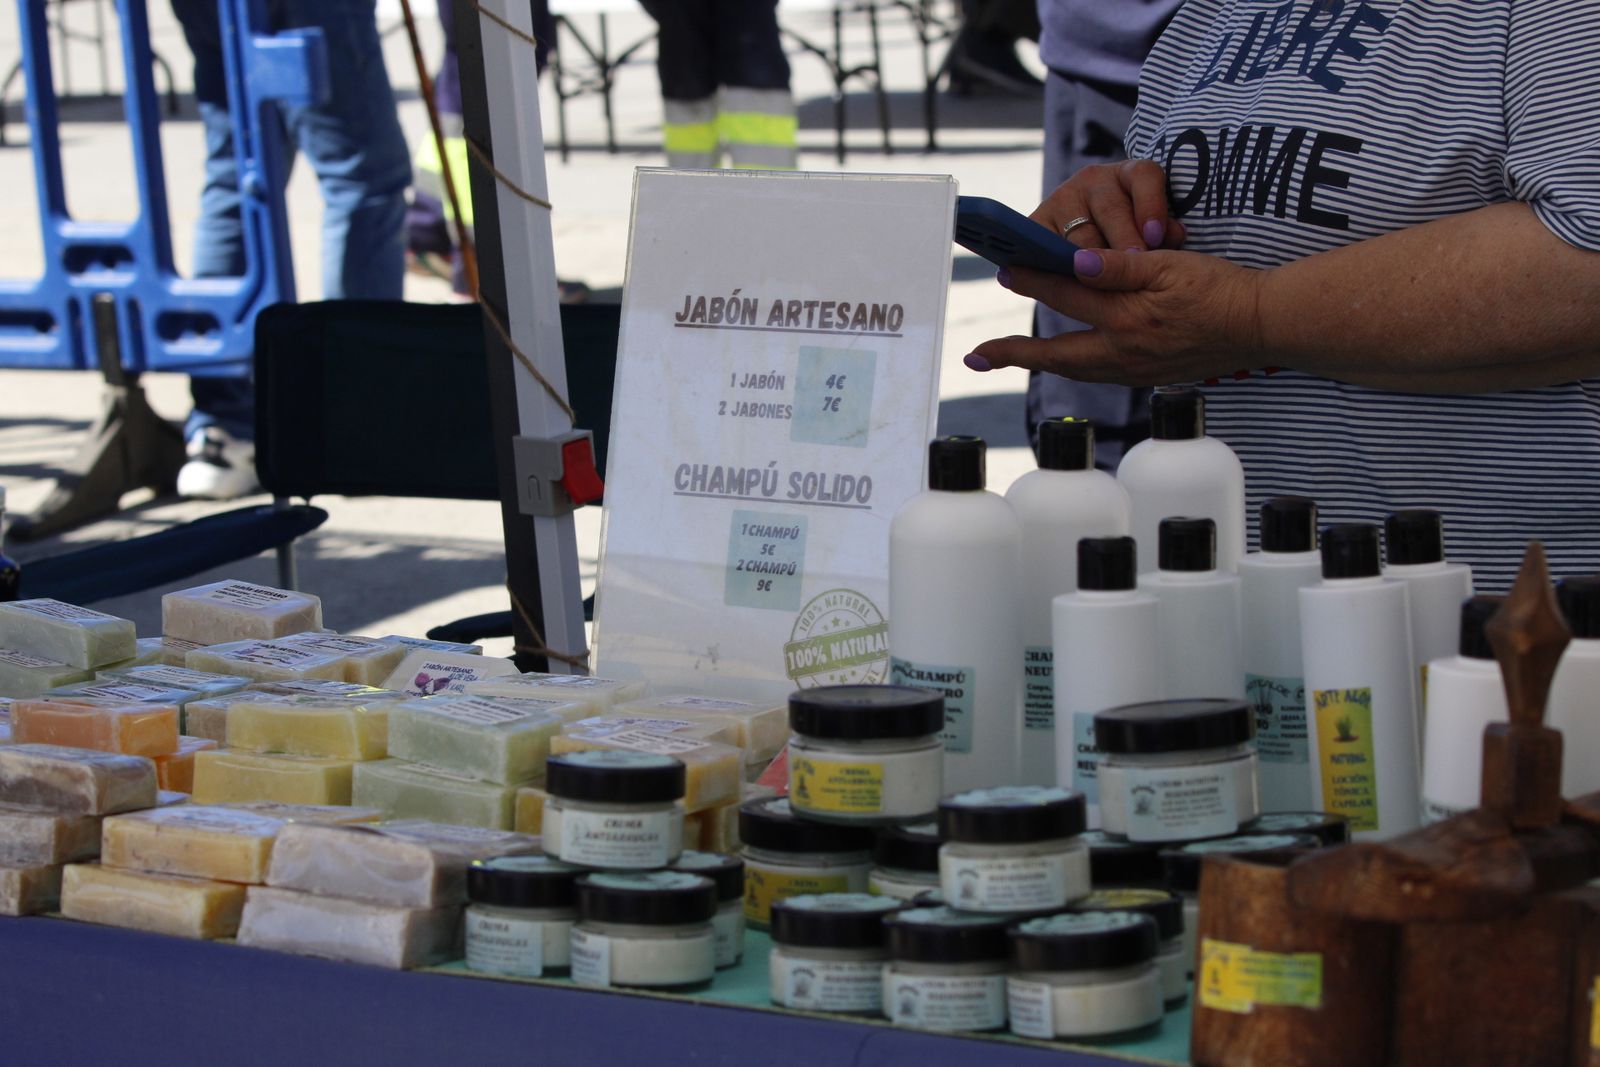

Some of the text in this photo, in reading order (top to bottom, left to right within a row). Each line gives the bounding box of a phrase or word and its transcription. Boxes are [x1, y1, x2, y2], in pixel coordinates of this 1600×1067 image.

[1152, 124, 1365, 231] OMME
[675, 288, 904, 333] JABÓN ARTESANO
[730, 370, 847, 391] 1 JABÓN 4€
[718, 396, 842, 420] 2 JABONES 7€
[674, 461, 873, 504] CHAMPÚ SOLIDO
[742, 523, 800, 540] 1 CHAMPÚ
[760, 543, 776, 556] 5€
[736, 559, 797, 576] 2 CHAMPÚ
[756, 579, 773, 592] 9€
[824, 594, 871, 619] NATURAL
[787, 644, 828, 672] 100%
[909, 667, 967, 684] CHAMPÚ
